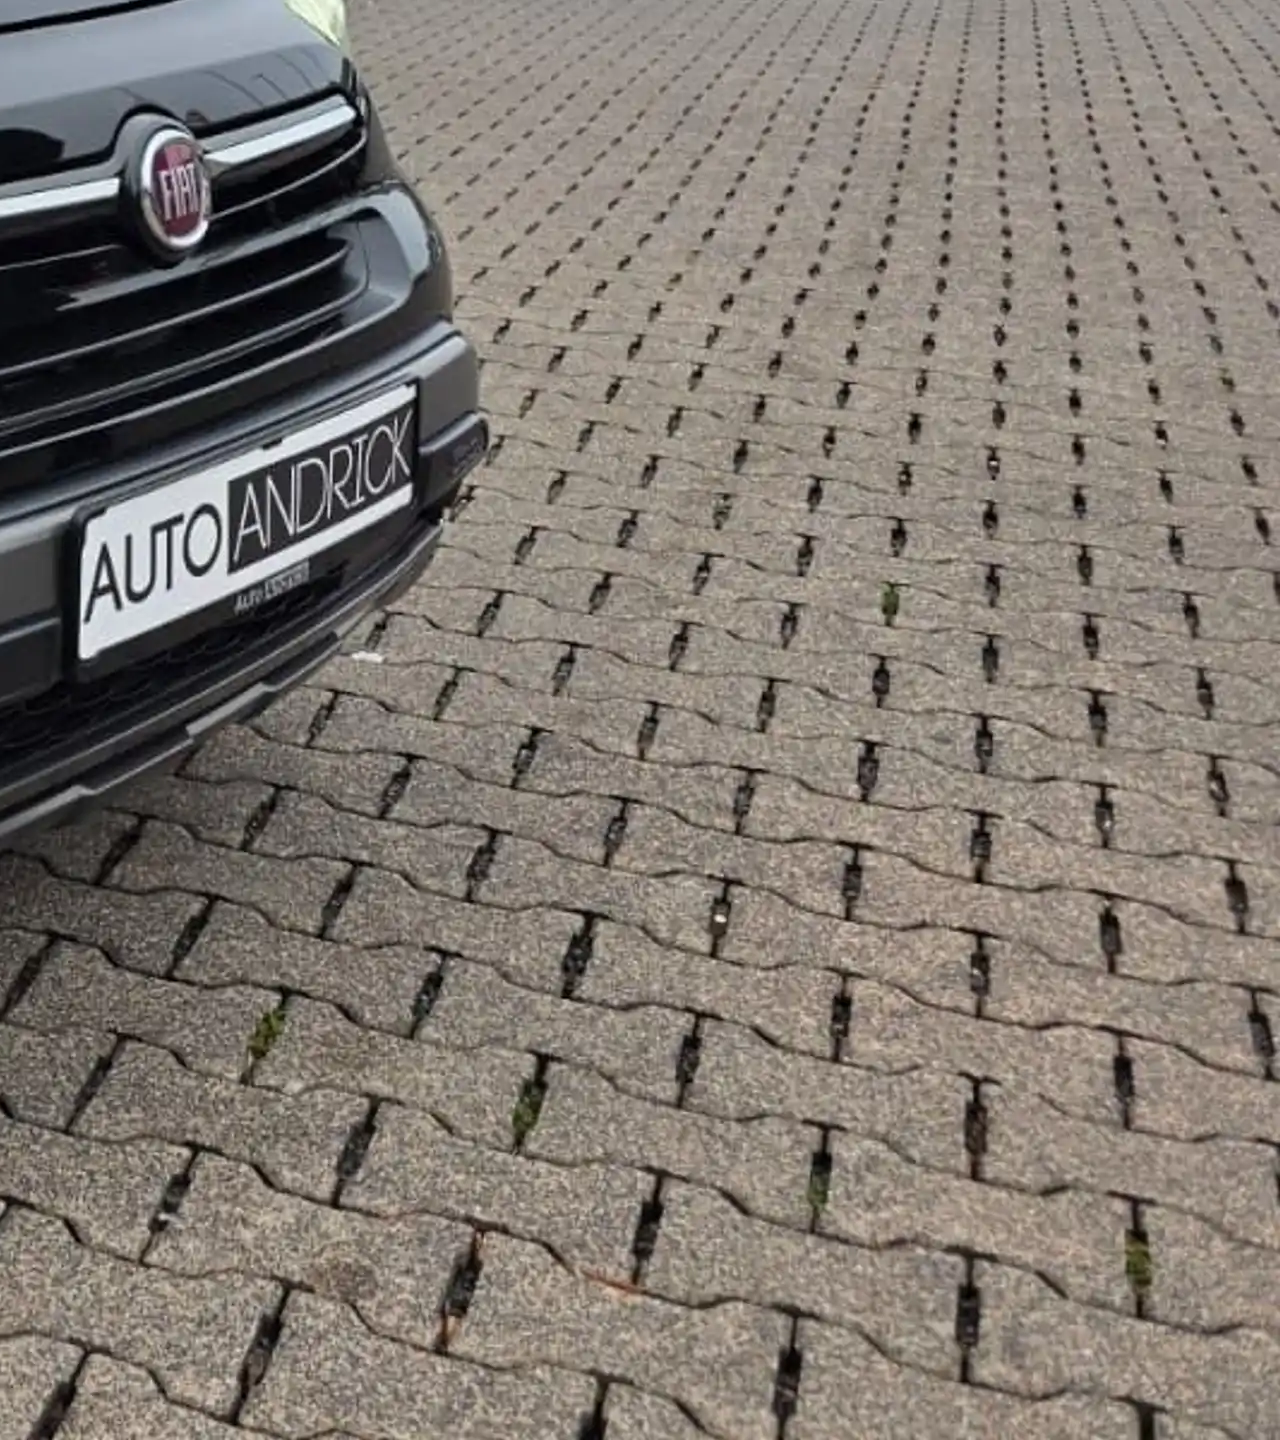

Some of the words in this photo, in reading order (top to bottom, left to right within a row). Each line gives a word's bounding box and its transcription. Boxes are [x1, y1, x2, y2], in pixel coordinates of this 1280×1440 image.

[158, 162, 200, 221] FIAT
[83, 502, 222, 625] AUTO
[232, 406, 413, 564] ANDRICK
